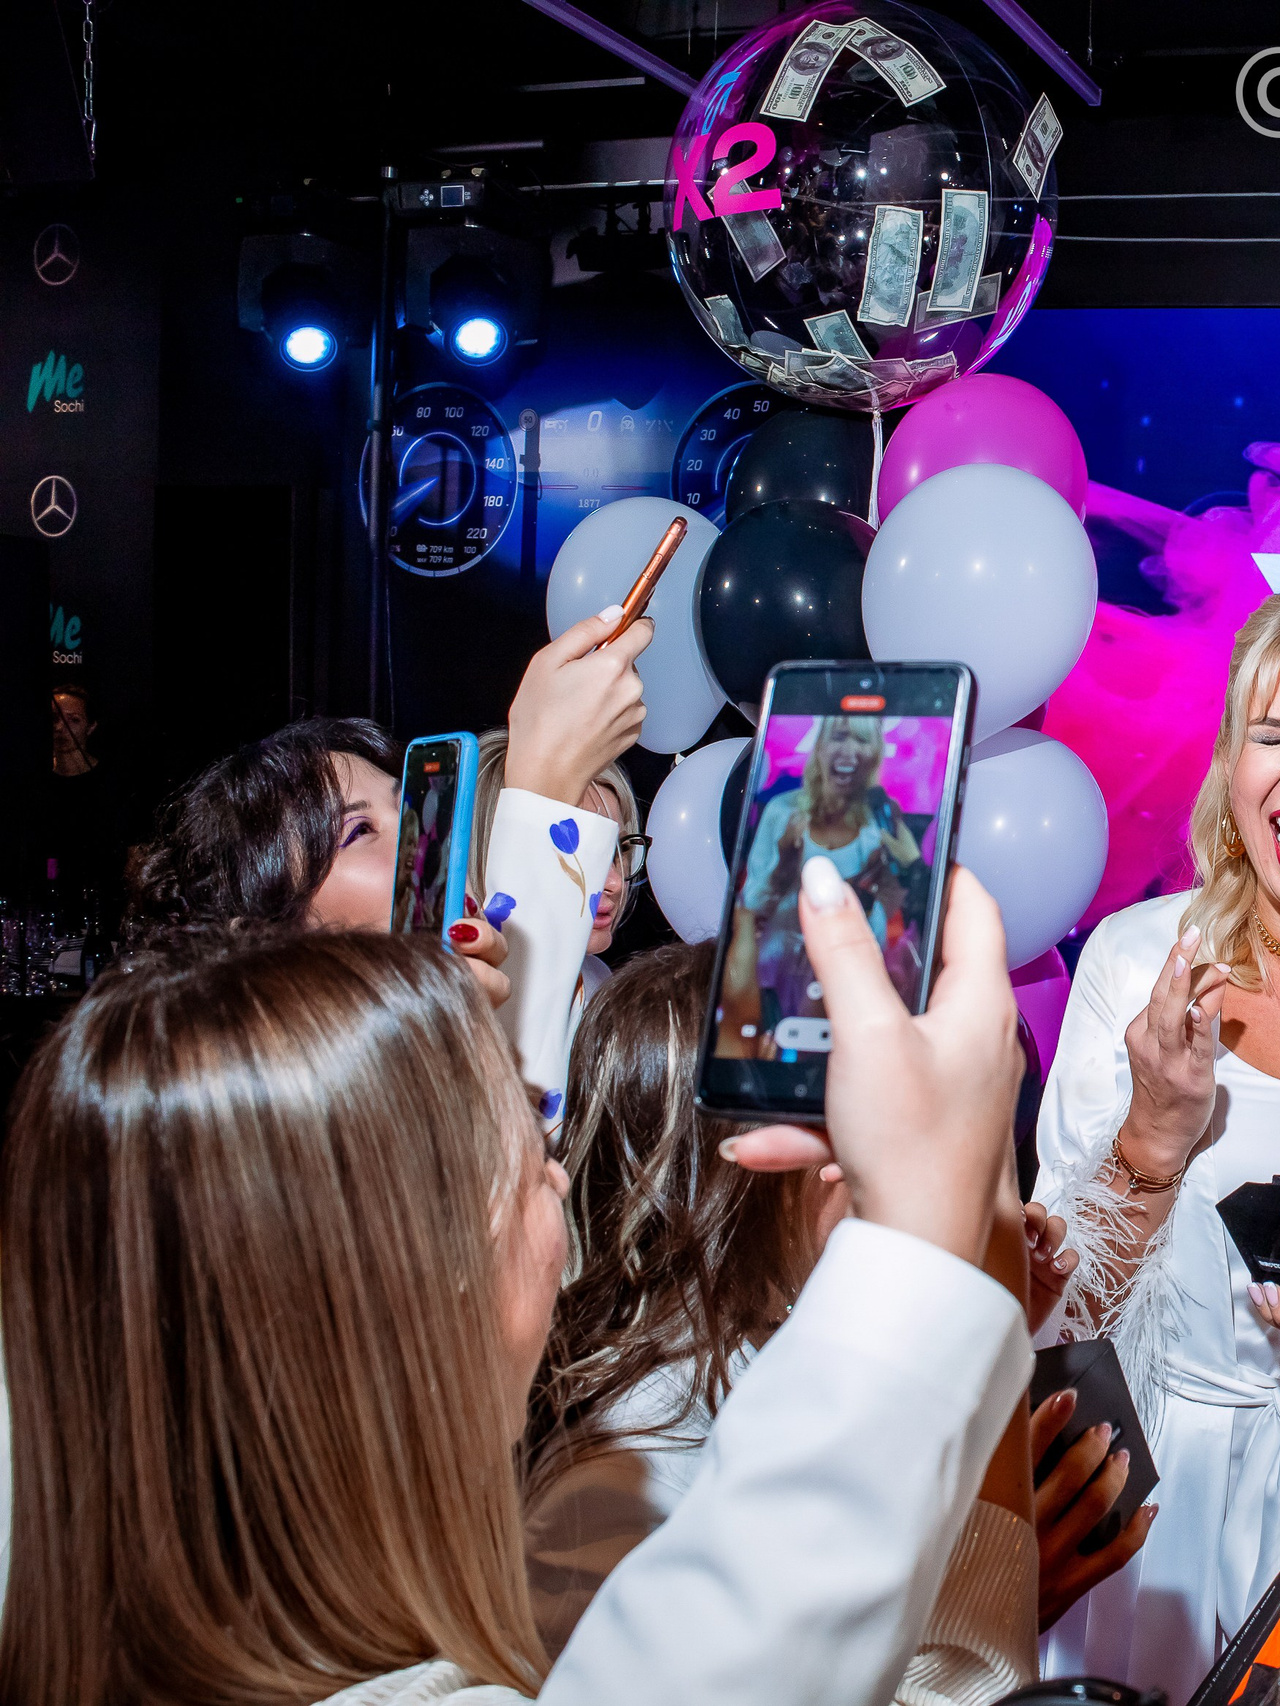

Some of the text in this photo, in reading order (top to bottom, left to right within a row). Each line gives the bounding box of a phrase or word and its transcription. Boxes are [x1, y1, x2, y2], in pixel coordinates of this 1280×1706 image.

[672, 122, 782, 232] X2
[26, 350, 84, 413] Me
[54, 400, 85, 413] Sochi
[753, 400, 770, 412] 50
[416, 407, 464, 418] 80 100
[723, 408, 741, 420] 40
[523, 415, 533, 424] 50
[587, 410, 603, 432] 0
[471, 425, 489, 437] 120
[700, 429, 717, 441] 30
[485, 457, 504, 470] 140
[686, 459, 703, 471] 20
[483, 495, 503, 507] 180
[687, 492, 701, 505] 10
[466, 527, 487, 539] 220
[429, 545, 443, 554] 709
[463, 546, 477, 554] 100
[52, 650, 83, 664] Sochi
